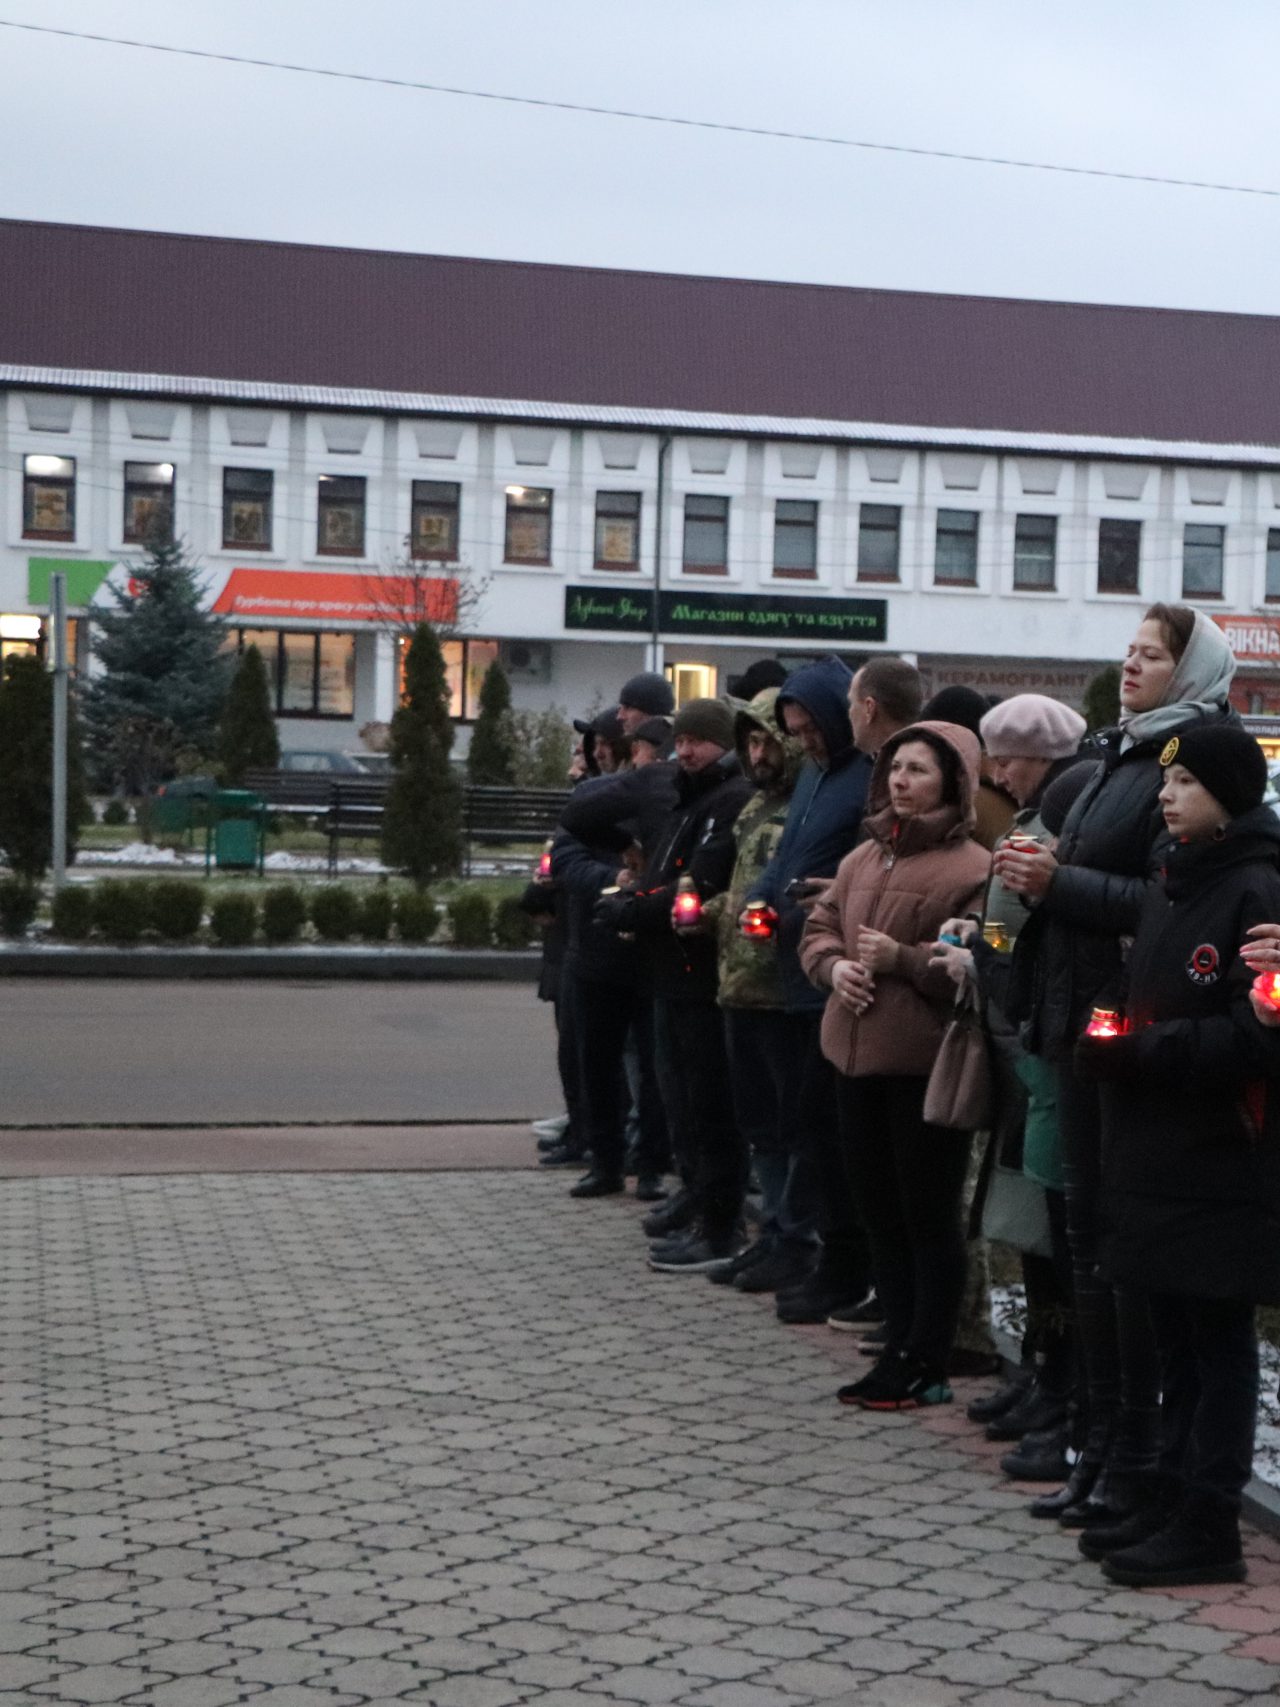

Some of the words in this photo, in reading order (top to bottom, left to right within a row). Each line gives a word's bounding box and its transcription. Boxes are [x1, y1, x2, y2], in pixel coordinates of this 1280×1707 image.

[672, 604, 744, 622] Магазин
[748, 611, 792, 628] одягу
[795, 612, 815, 625] та
[819, 613, 878, 629] взуття
[1224, 627, 1280, 654] ВІКНА
[937, 670, 1087, 687] КЕРАМОГРАНІТ
